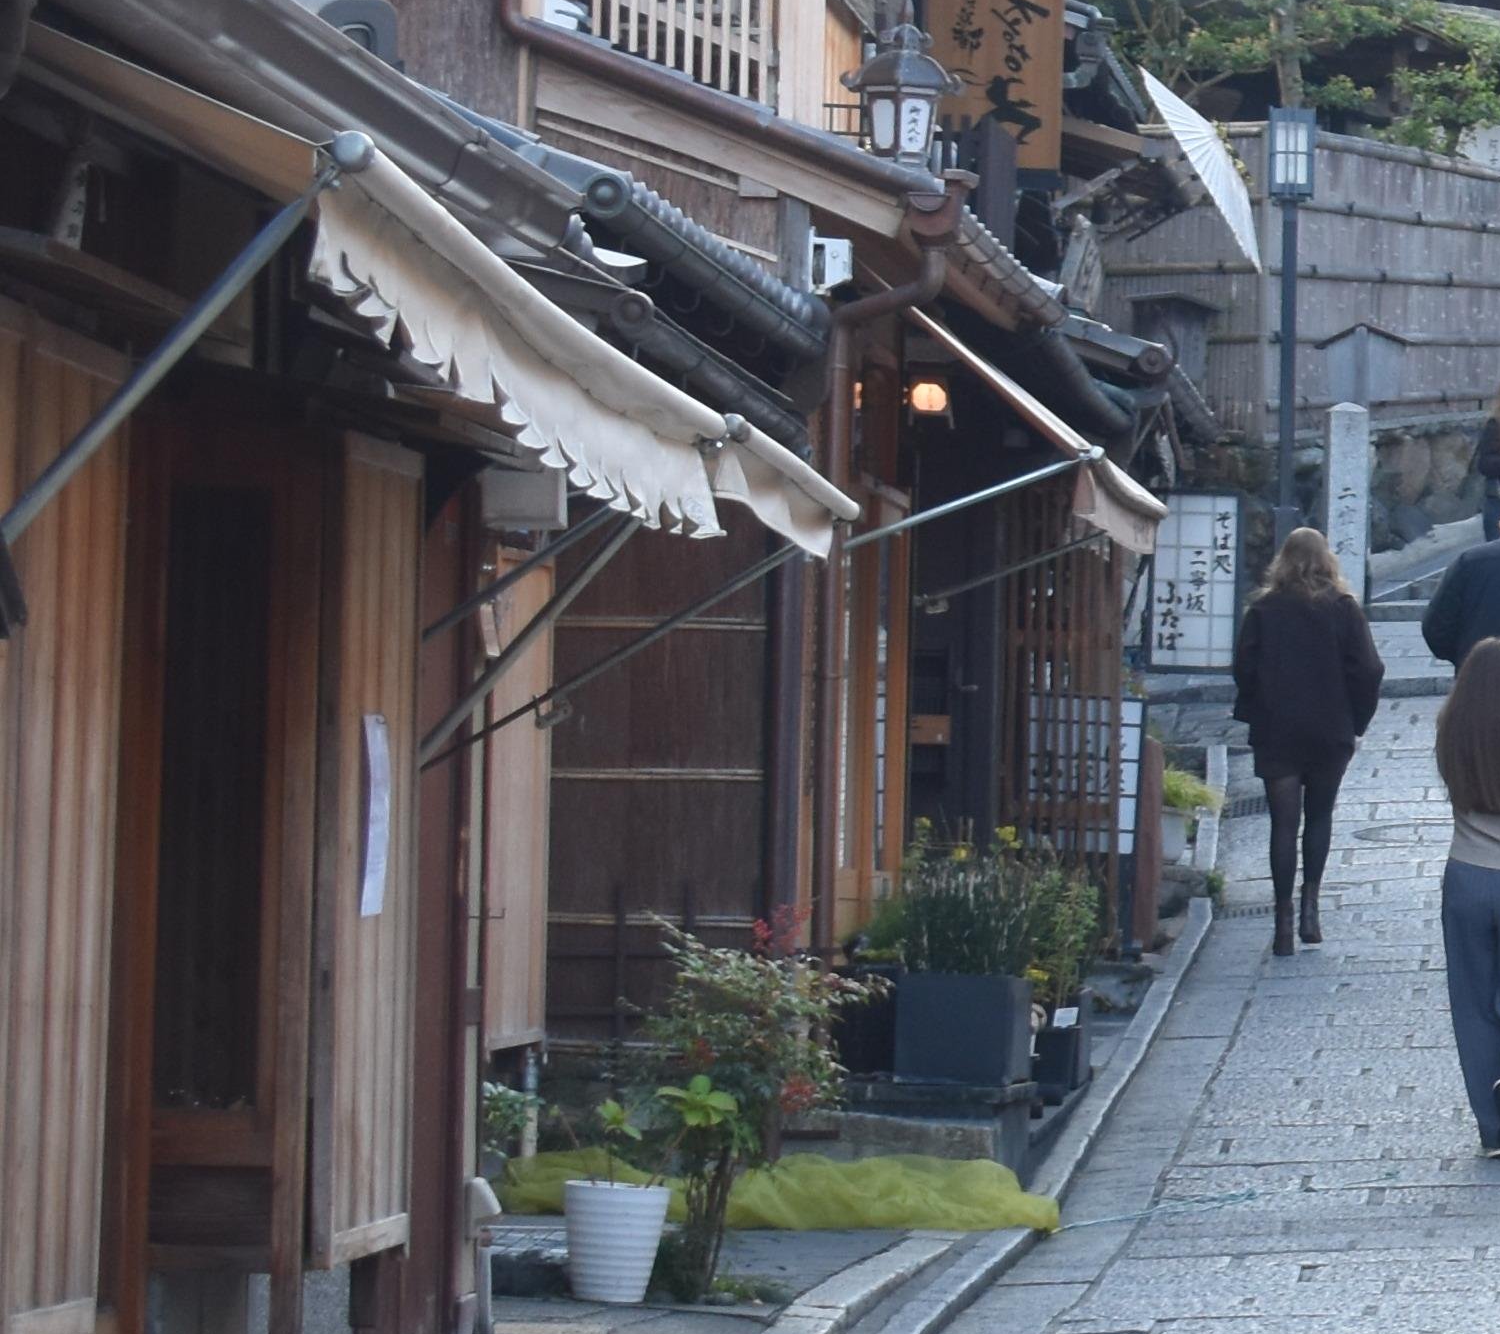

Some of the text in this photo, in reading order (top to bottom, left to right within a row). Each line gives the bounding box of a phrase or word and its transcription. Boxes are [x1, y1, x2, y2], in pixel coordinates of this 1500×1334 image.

[1213, 512, 1233, 574] そば処
[1157, 581, 1184, 651] ふたば
